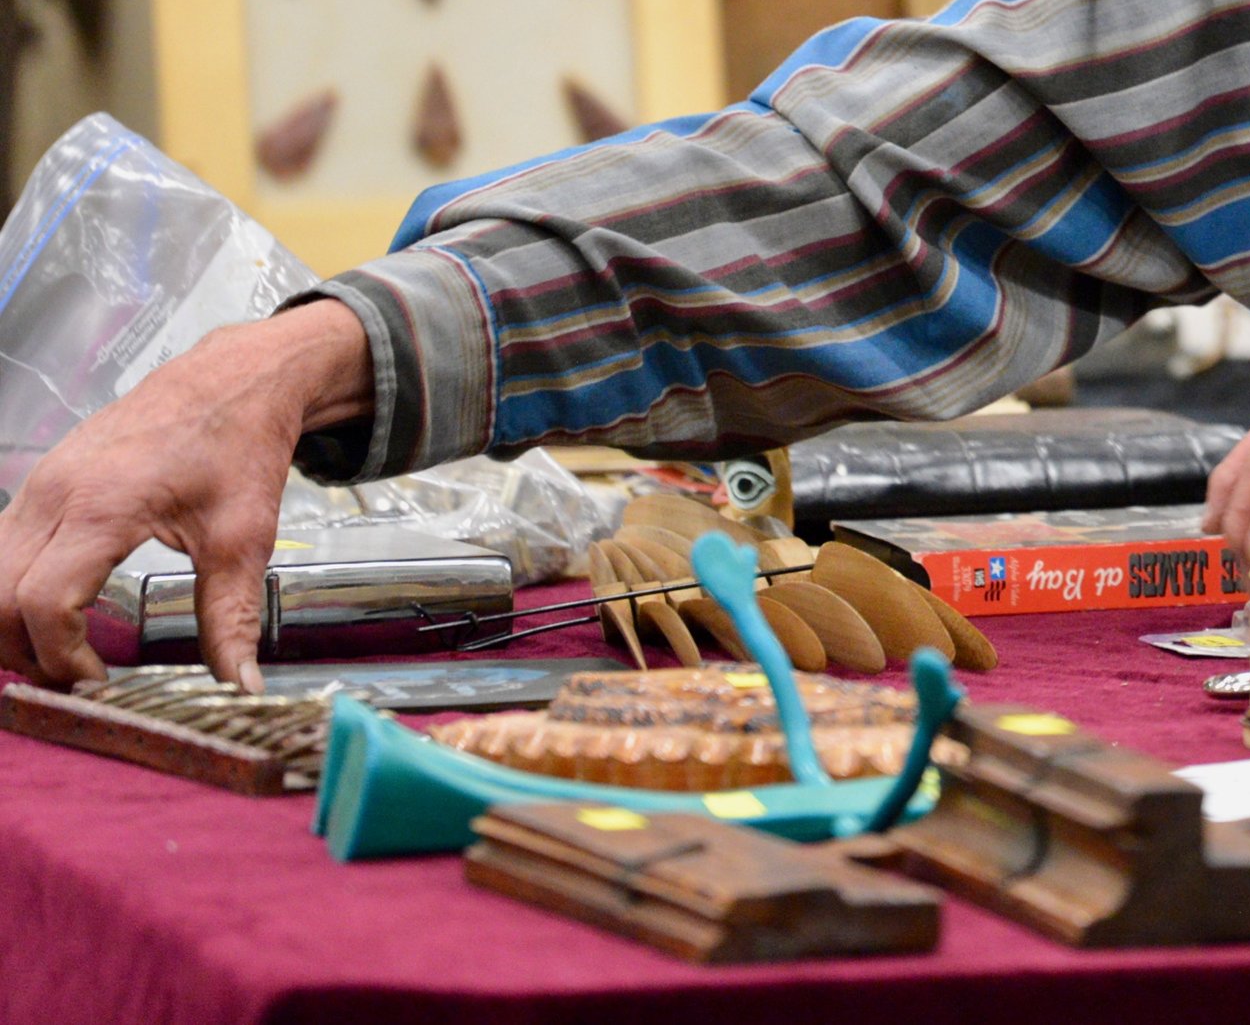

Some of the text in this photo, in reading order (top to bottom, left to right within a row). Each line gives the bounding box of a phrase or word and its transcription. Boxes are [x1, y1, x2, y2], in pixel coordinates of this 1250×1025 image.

[974, 569, 985, 587] VHS
[1026, 560, 1082, 600] Bay
[1094, 566, 1124, 596] at
[1129, 550, 1209, 598] JAMES
